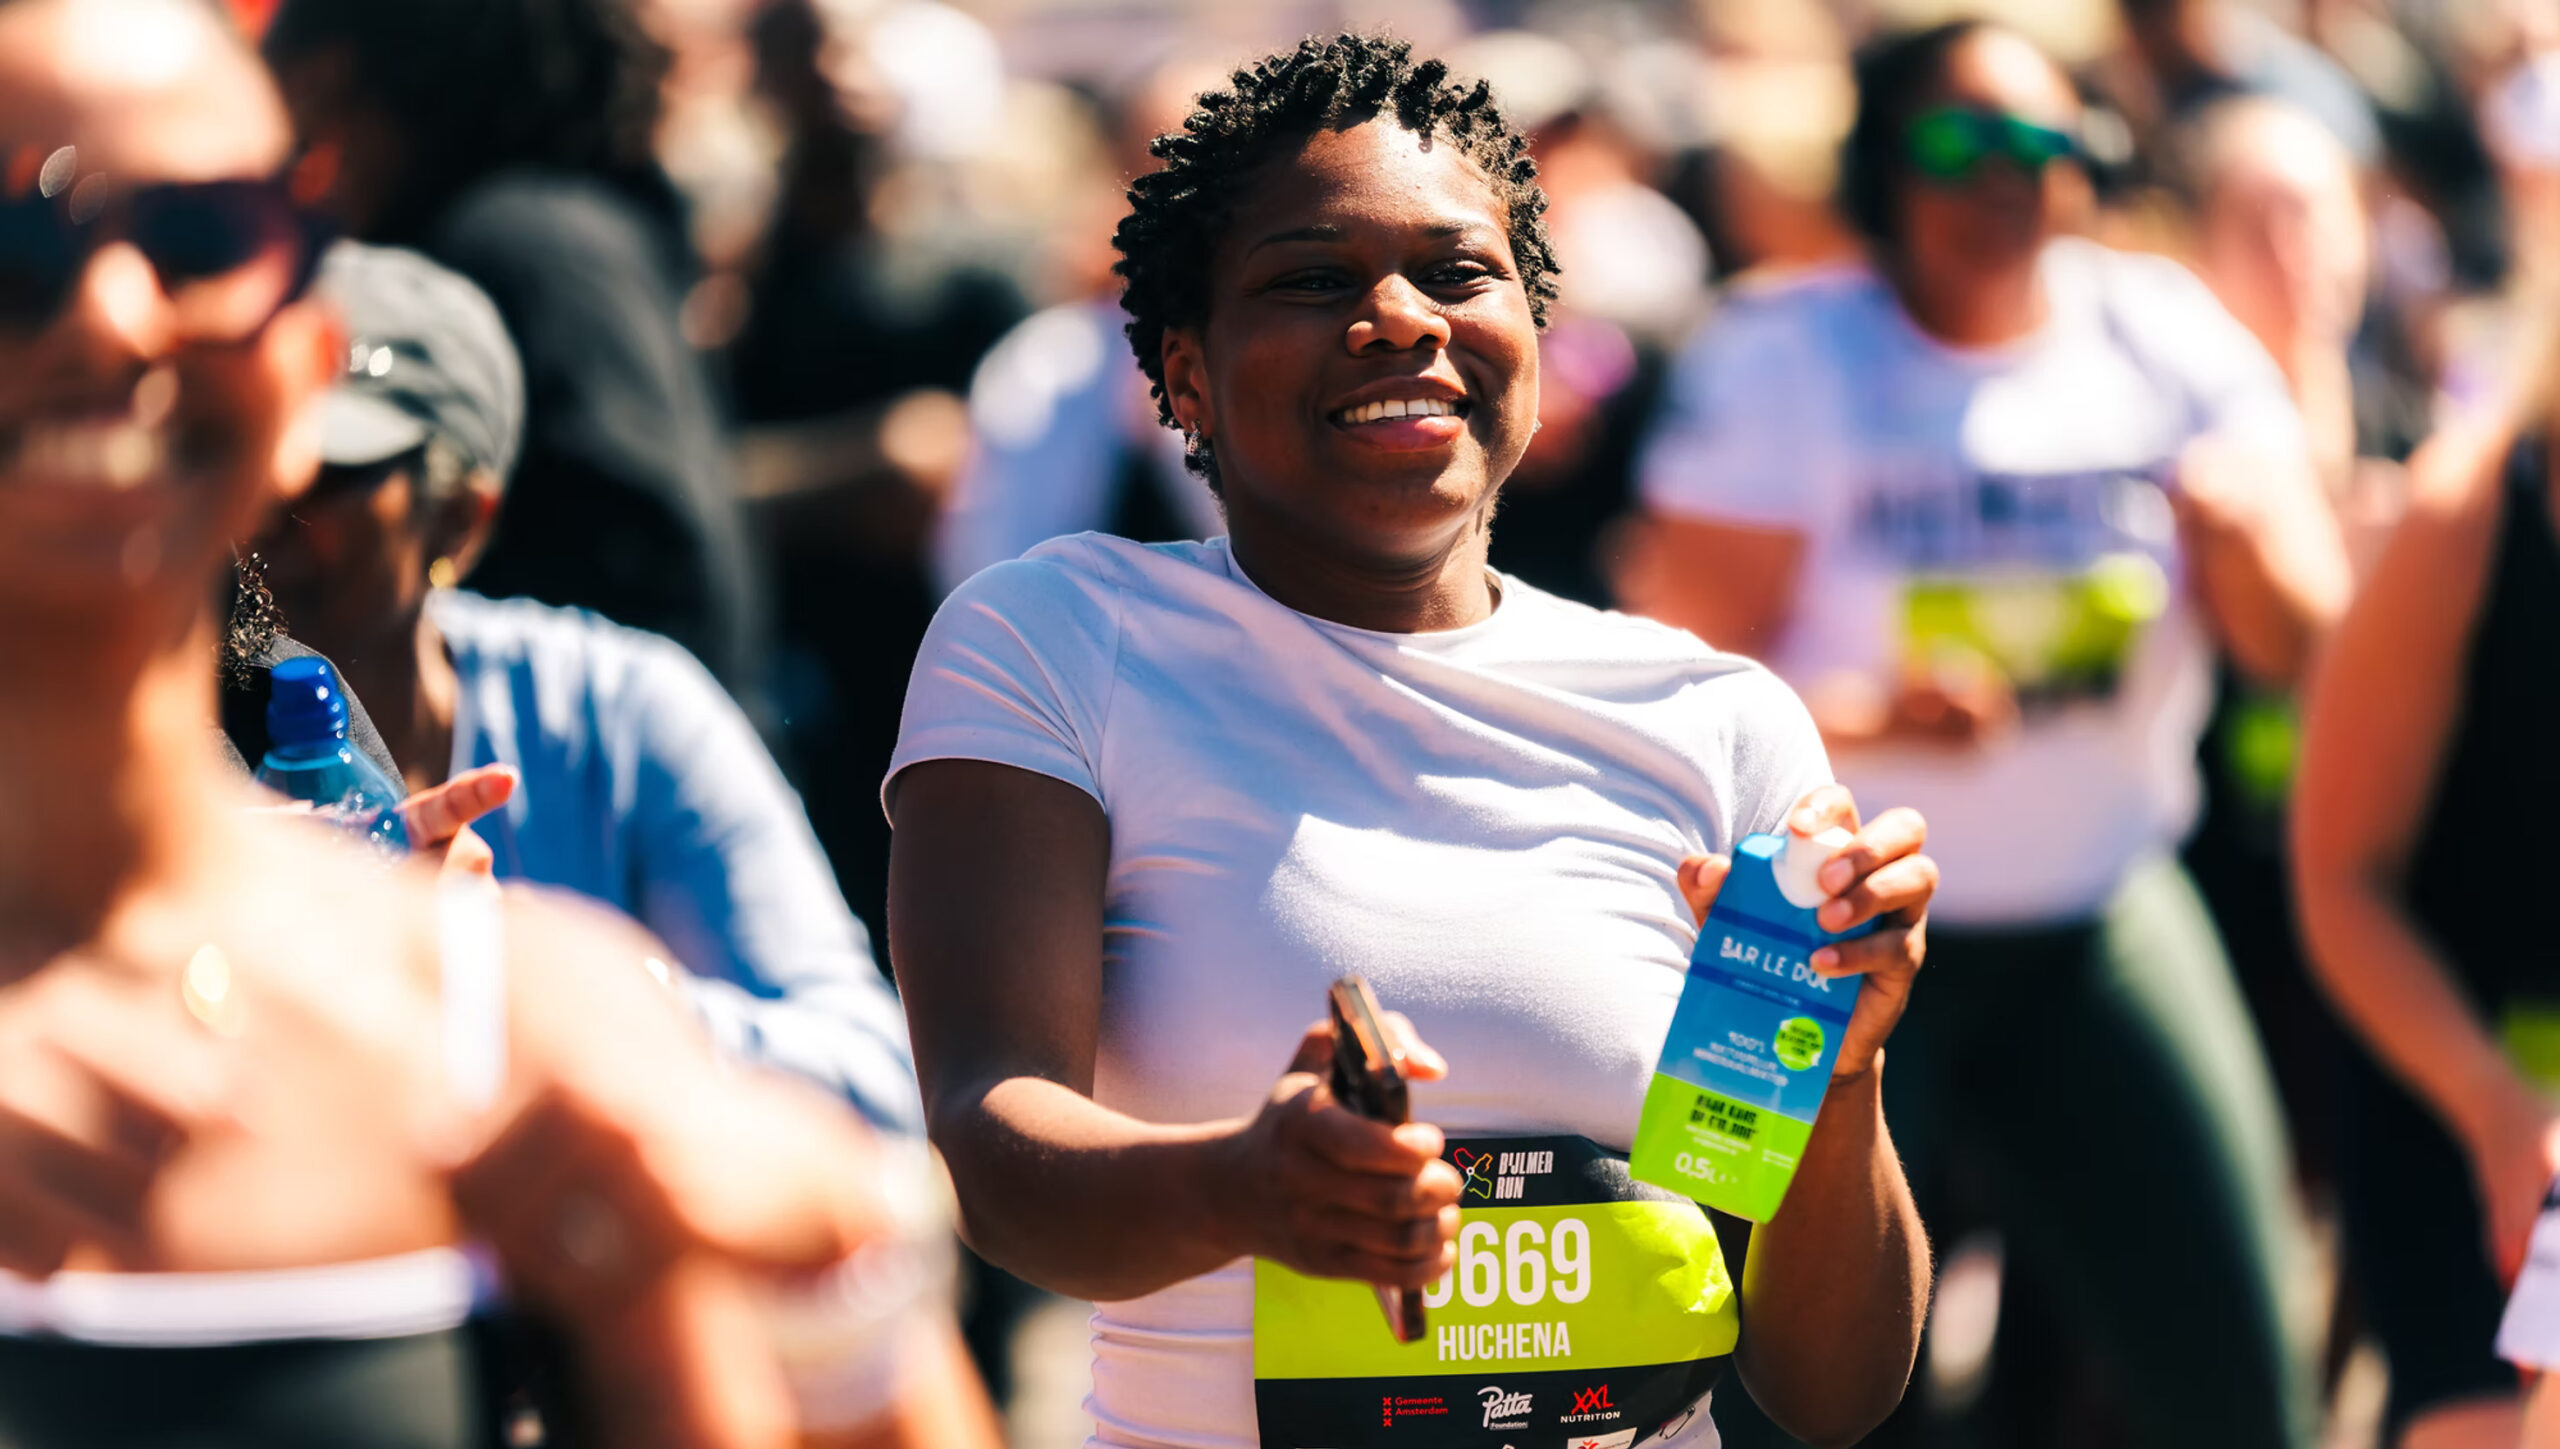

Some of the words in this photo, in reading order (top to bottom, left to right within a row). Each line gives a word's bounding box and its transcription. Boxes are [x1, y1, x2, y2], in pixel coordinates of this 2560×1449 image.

[1720, 936, 1759, 967] BAR
[1762, 952, 1787, 977] LE
[1498, 1151, 1554, 1175] BIJLMER
[1495, 1176, 1524, 1199] RUN
[1438, 1322, 1571, 1361] HUCHENA
[1395, 1396, 1443, 1406] Gemeente
[1395, 1406, 1448, 1416] Amsterdam
[1477, 1386, 1533, 1428] Patta
[1571, 1384, 1614, 1415] XXL
[1490, 1421, 1528, 1430] Foundation
[1560, 1411, 1621, 1424] NUTRITION
